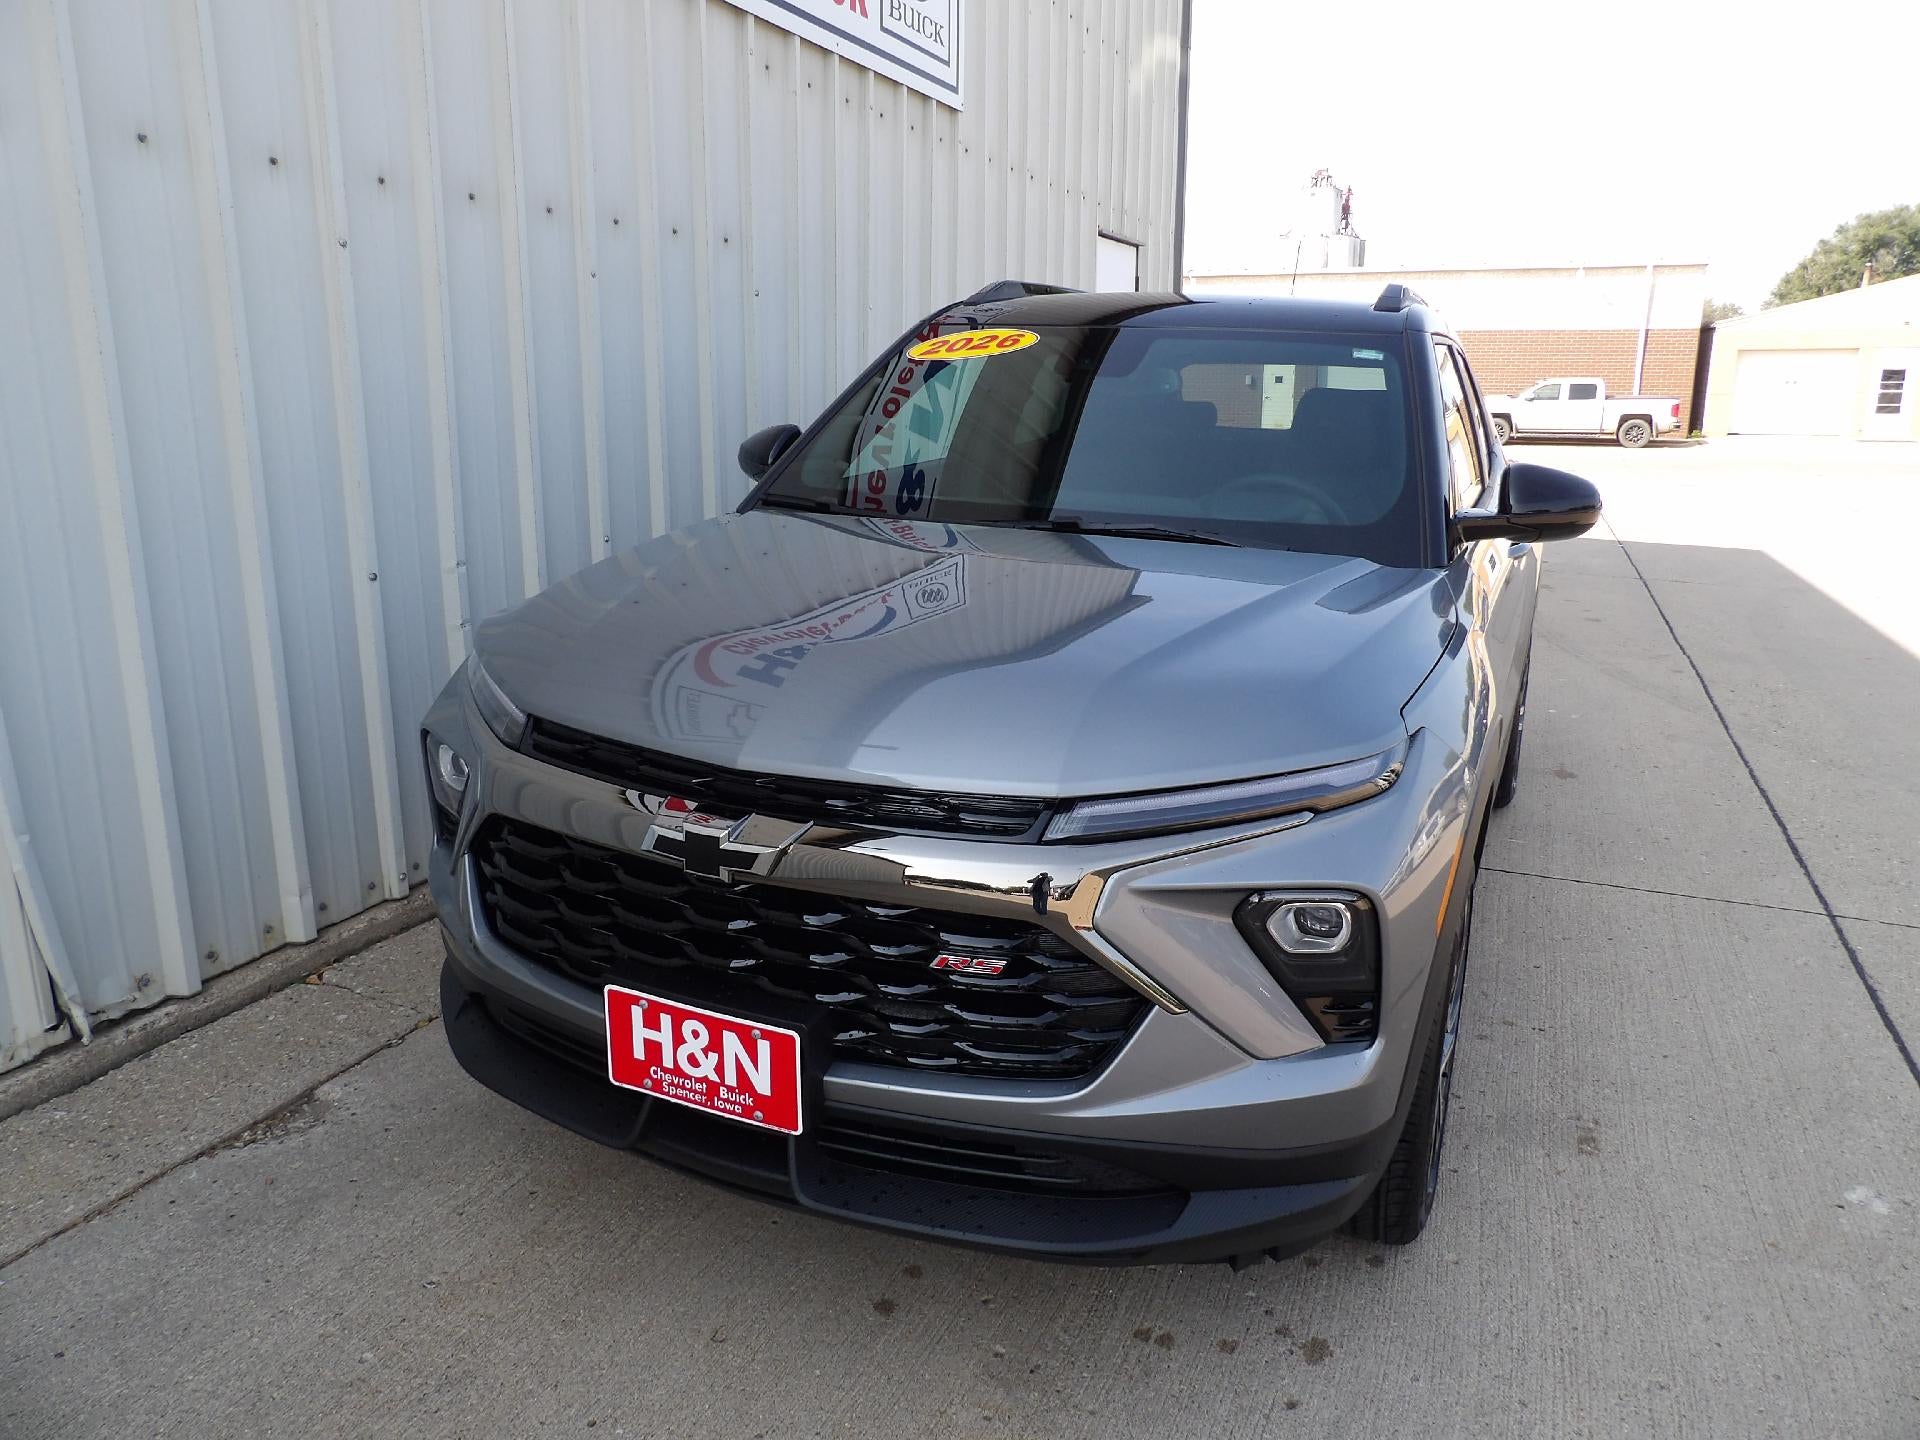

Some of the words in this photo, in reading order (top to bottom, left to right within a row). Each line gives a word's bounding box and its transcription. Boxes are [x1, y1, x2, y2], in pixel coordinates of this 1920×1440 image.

[888, 0, 945, 48] BUICK
[917, 333, 1026, 356] 2026
[929, 954, 1008, 975] RS
[631, 1004, 771, 1097] H&N
[650, 1066, 707, 1092] Chevrolet
[720, 1086, 754, 1106] Buick
[662, 1083, 711, 1106] Spencer,
[714, 1097, 742, 1114] Iowa
